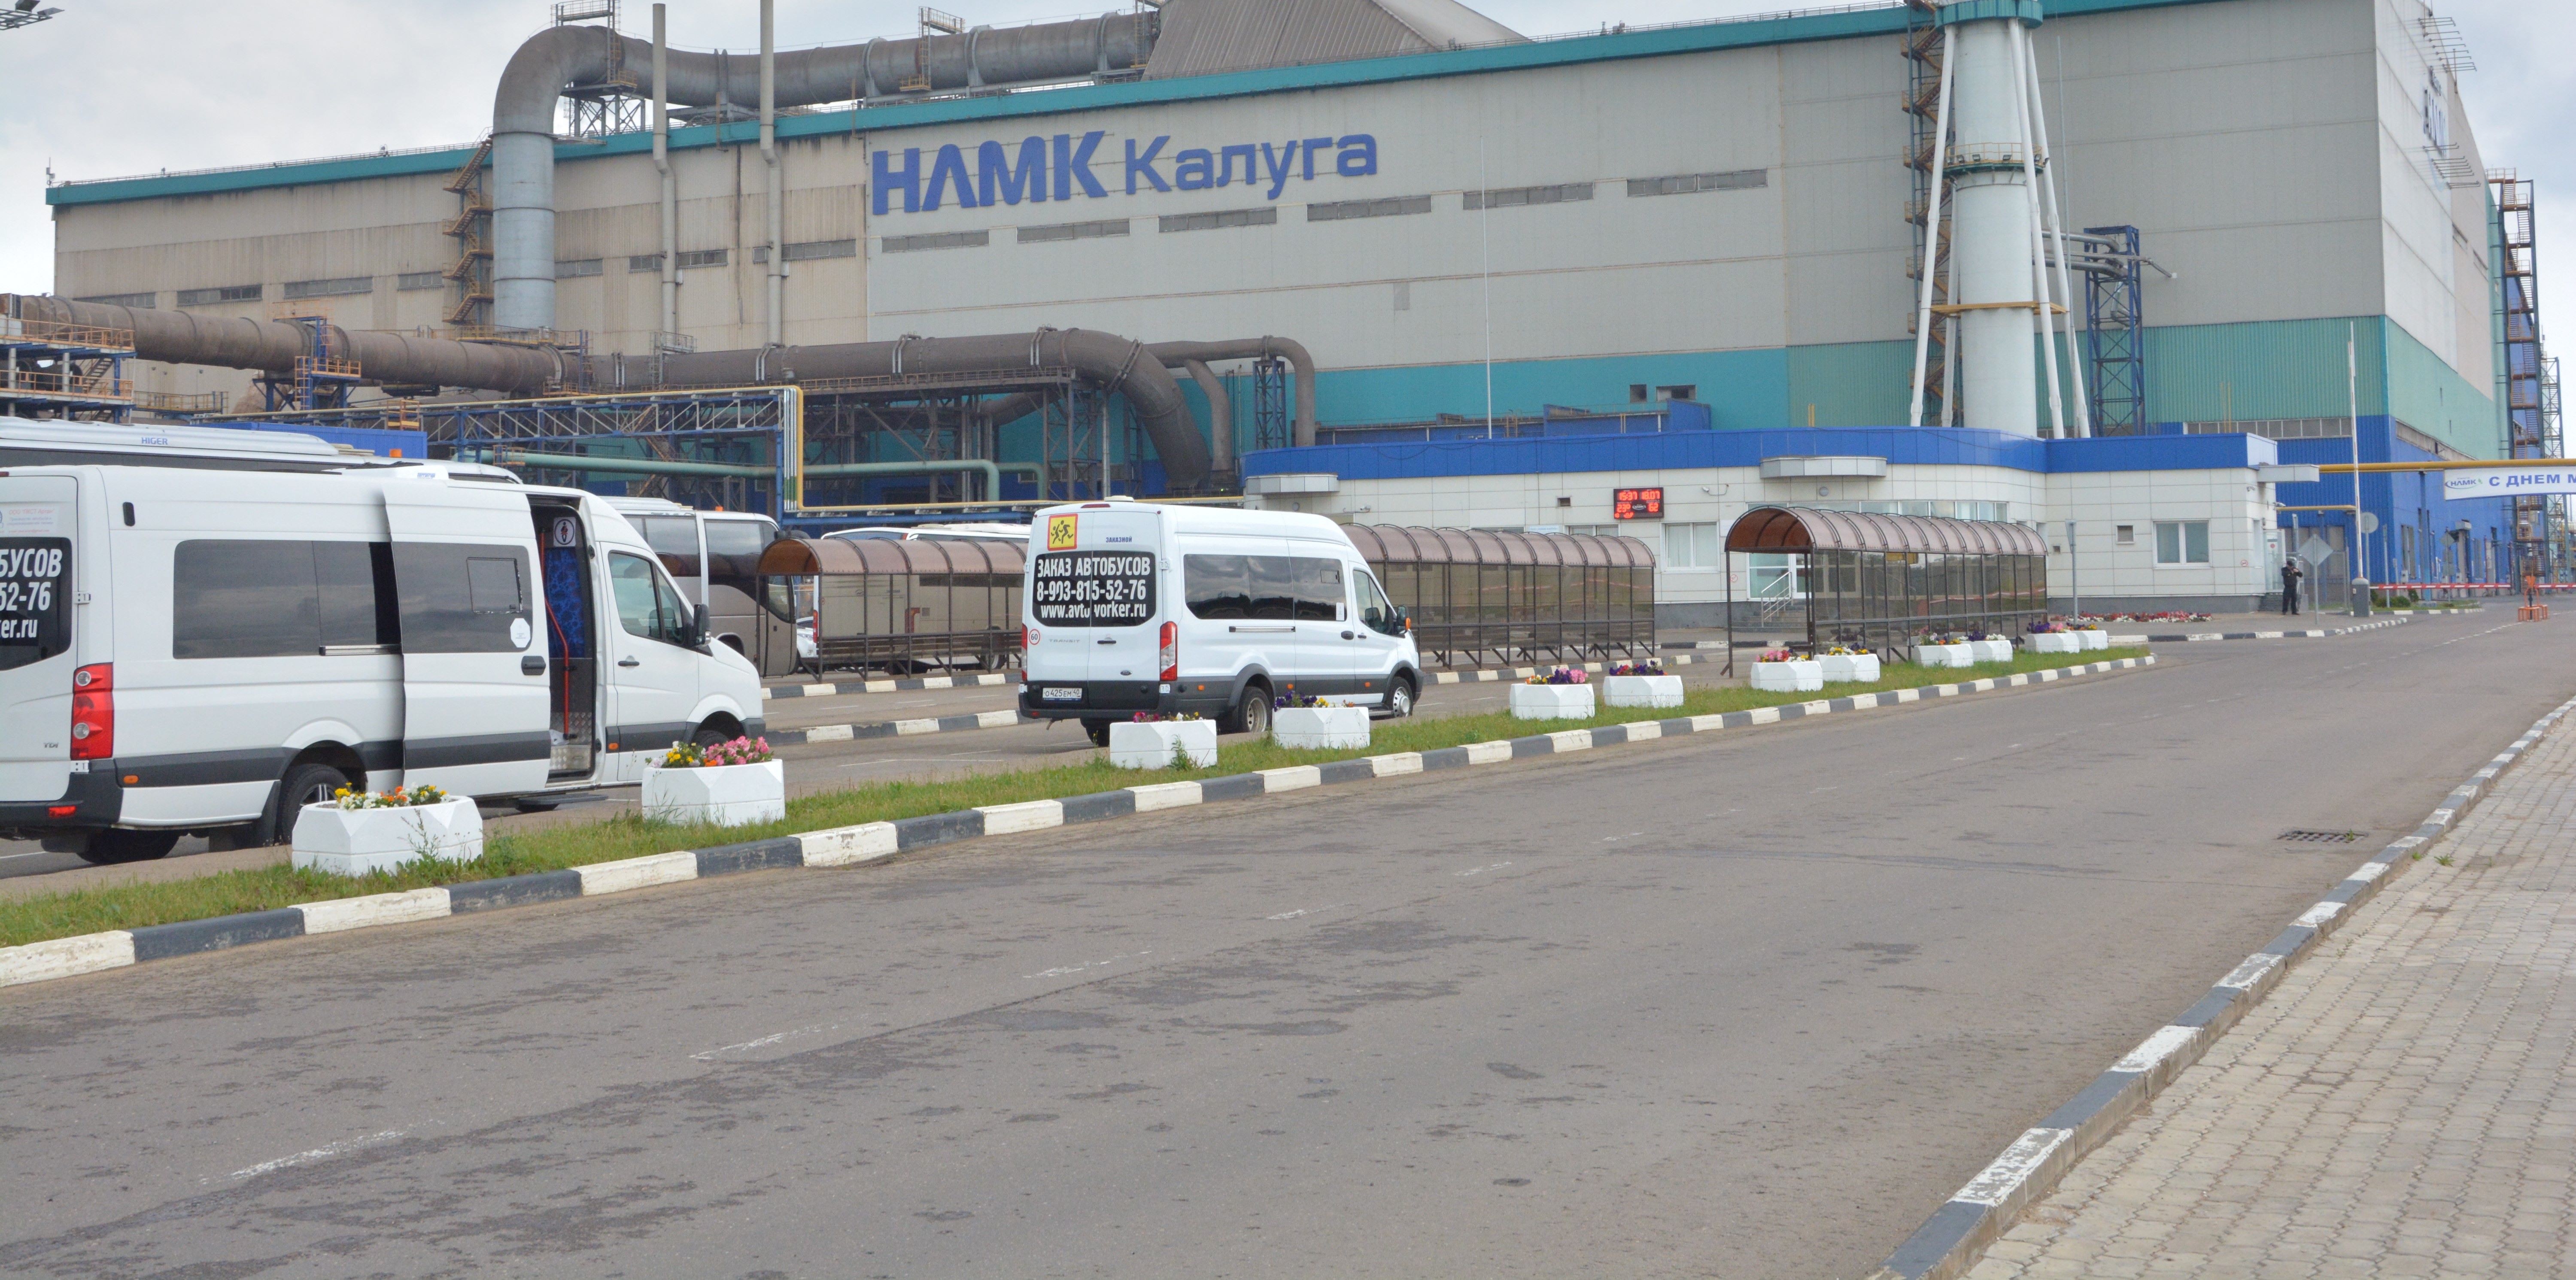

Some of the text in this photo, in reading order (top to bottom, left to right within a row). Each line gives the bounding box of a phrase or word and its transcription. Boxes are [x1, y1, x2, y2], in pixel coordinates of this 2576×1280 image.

[872, 130, 1377, 215] НЛМК Калуга
[2489, 476, 2500, 486] С
[2506, 474, 2560, 487] ДНЕМ
[1037, 557, 1151, 577] ЗАКАЗ АВТОБУСОВ
